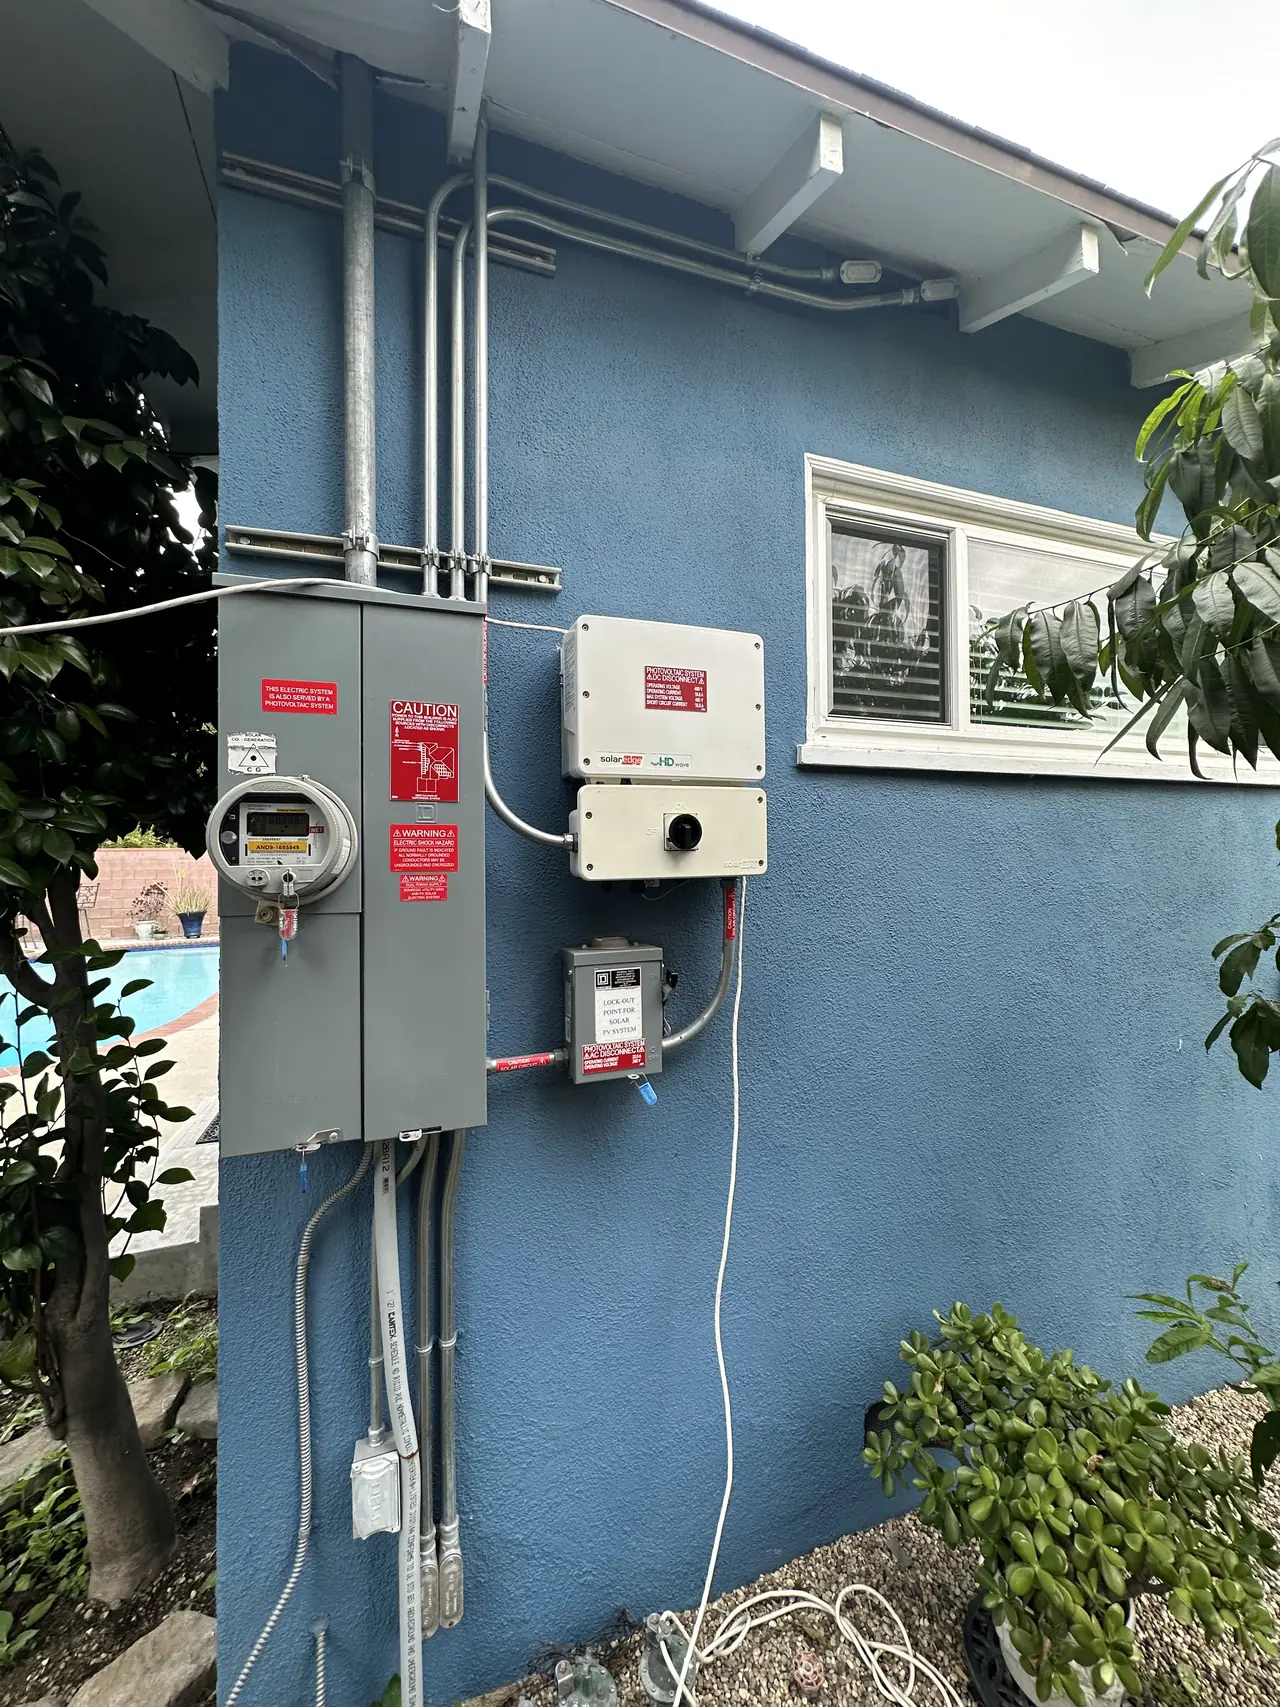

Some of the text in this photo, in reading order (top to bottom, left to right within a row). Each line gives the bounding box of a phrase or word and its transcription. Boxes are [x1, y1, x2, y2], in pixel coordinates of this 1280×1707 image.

[646, 667, 684, 675] PHOTOVOLTAIC
[662, 675, 698, 683] DISCONNECT
[393, 702, 457, 717] CAUTION
[660, 757, 674, 766] HD
[603, 998, 635, 1006] LOCK-OUT
[584, 1042, 623, 1052] PHOTOVOLTAIC
[600, 1047, 639, 1057] DISCONNECT
[388, 1311, 397, 1339] CANTEX
[390, 1341, 399, 1366] SCHEDULE
[393, 1375, 402, 1392] RIGID
[394, 1393, 404, 1403] PVC
[397, 1404, 410, 1435] NONMETALLIC
[407, 1562, 414, 1571] TO
[407, 1572, 414, 1580] UL
